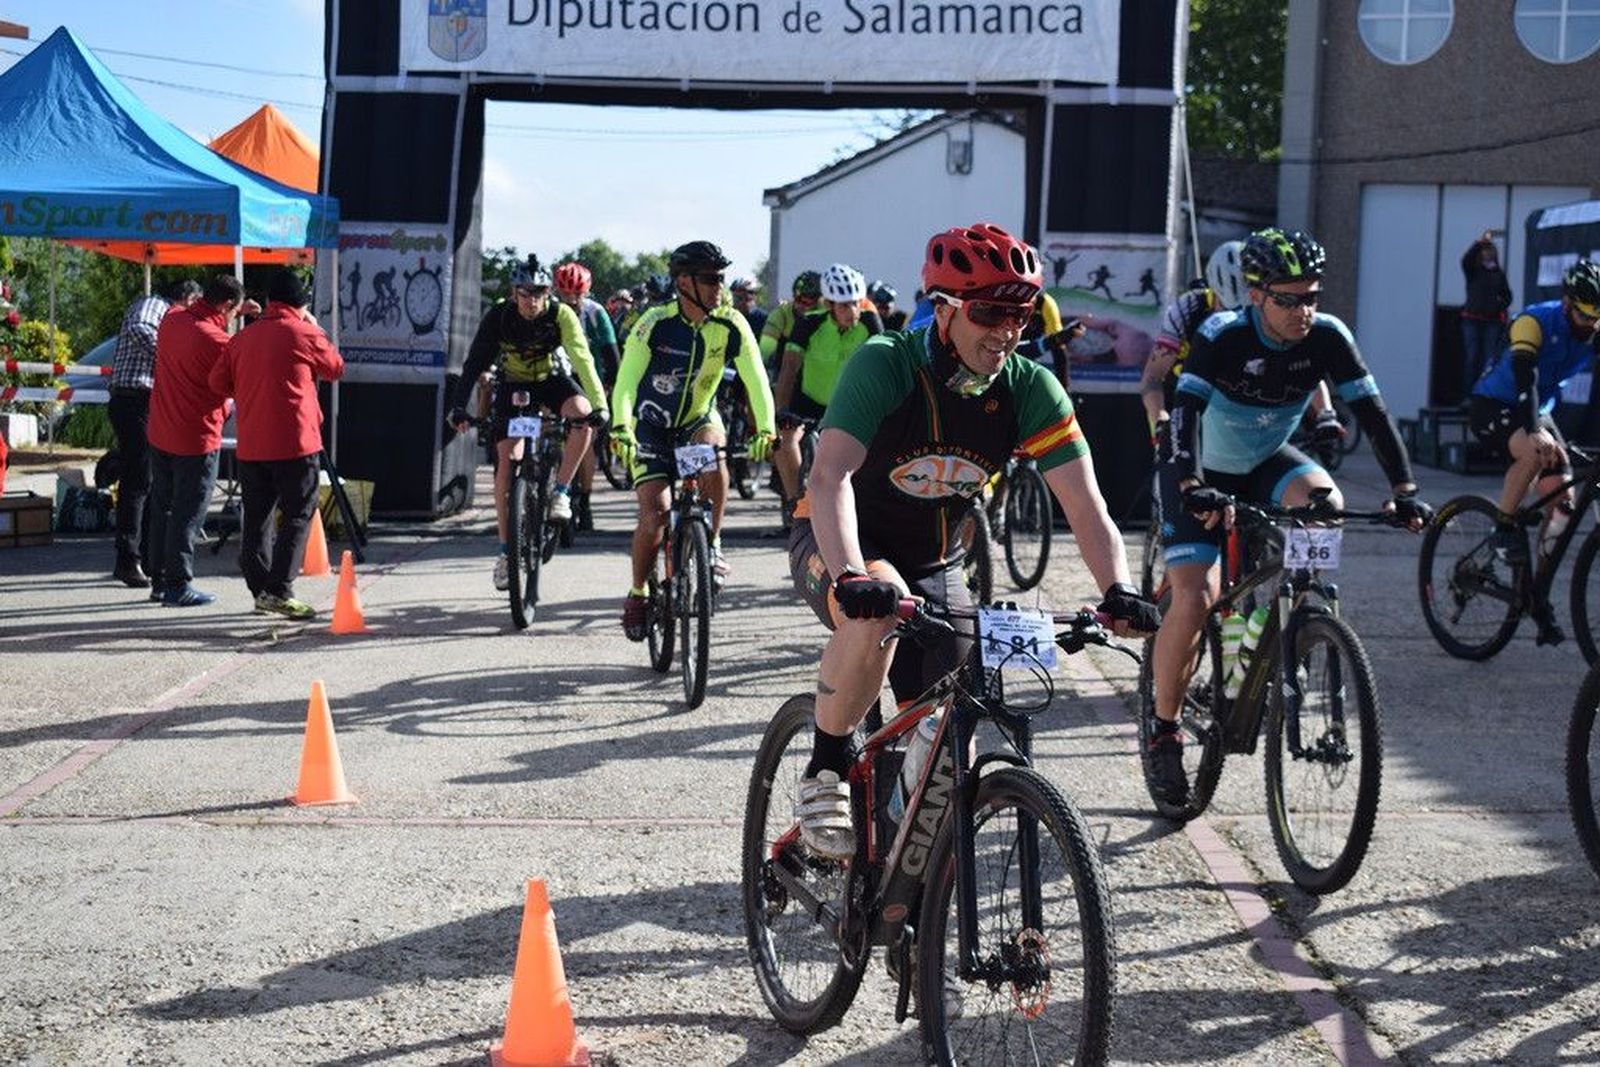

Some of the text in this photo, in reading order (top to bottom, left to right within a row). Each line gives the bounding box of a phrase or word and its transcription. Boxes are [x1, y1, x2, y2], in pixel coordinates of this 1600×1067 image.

[782, 0, 823, 34] de
[843, 0, 1084, 34] Salamanca
[1307, 546, 1330, 560] 66
[901, 745, 955, 876] GIANT
